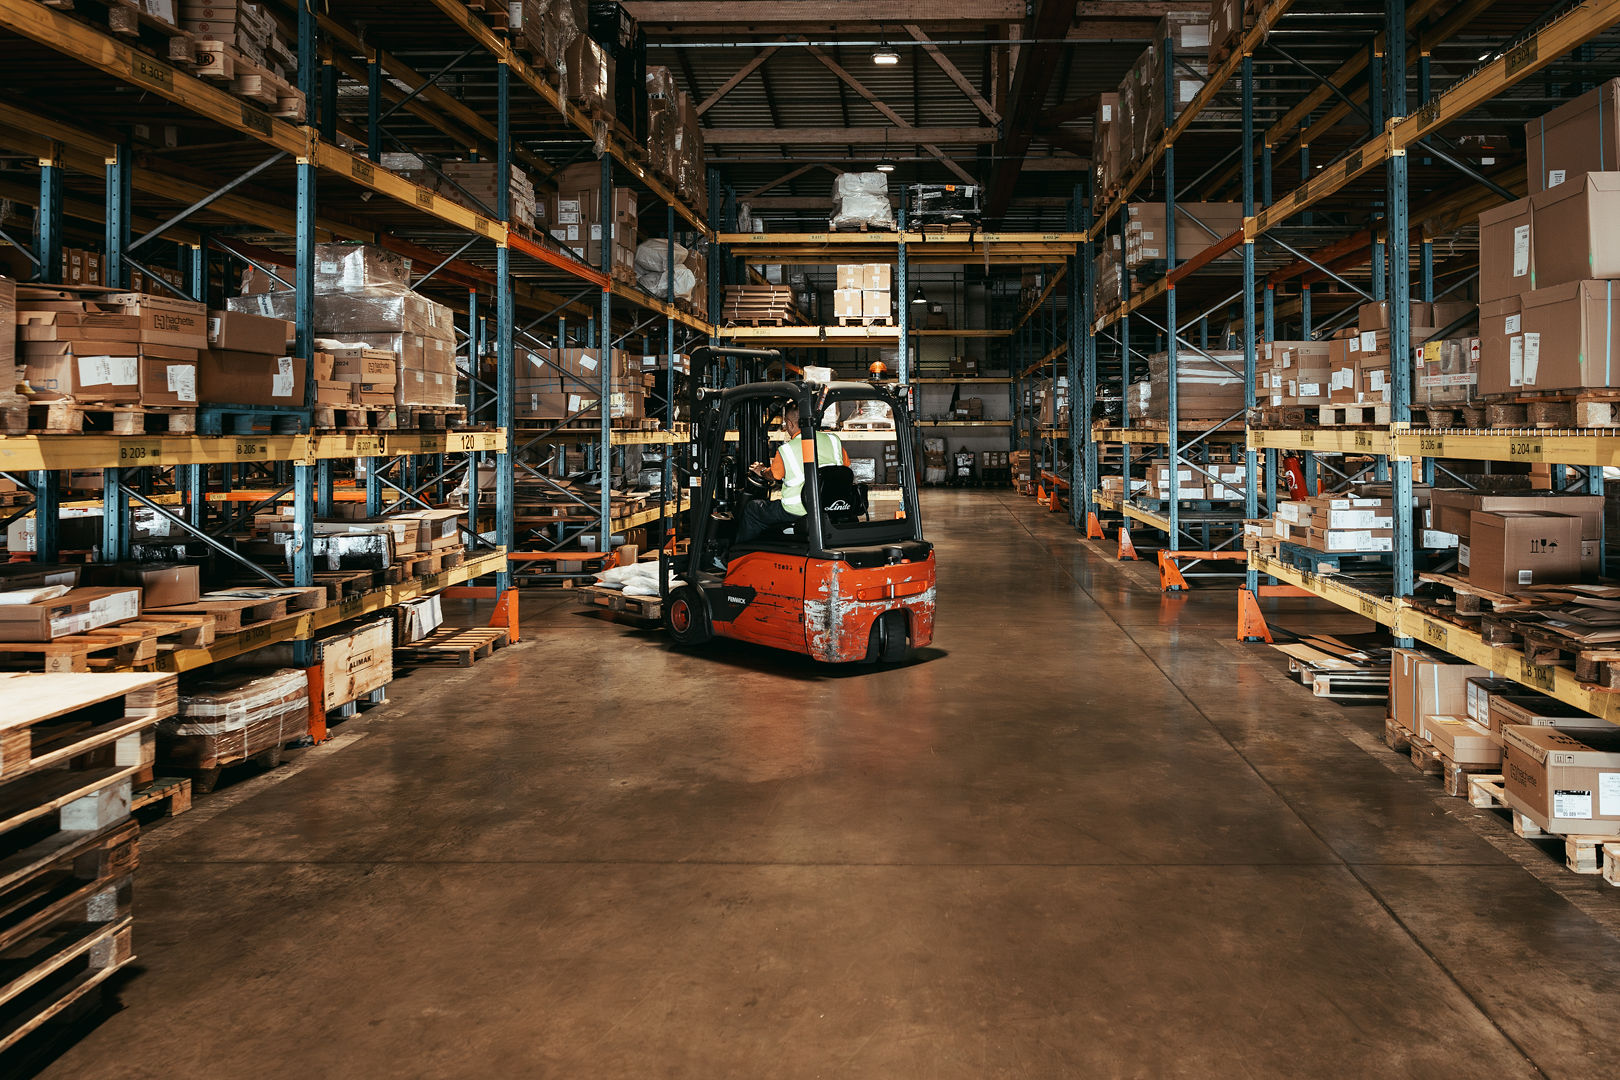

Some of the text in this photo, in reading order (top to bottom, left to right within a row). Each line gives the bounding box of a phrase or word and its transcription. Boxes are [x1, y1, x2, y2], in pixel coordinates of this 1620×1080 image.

[140, 62, 165, 82] B 303
[166, 314, 195, 327] hachette
[461, 434, 475, 449] 120
[1420, 441, 1435, 450] B 206
[121, 447, 146, 458] B 203
[237, 444, 256, 454] B 205
[1511, 443, 1530, 454] B 204
[824, 499, 851, 511] Linde
[349, 654, 373, 670] ALIMAK
[1527, 665, 1546, 680] B 104
